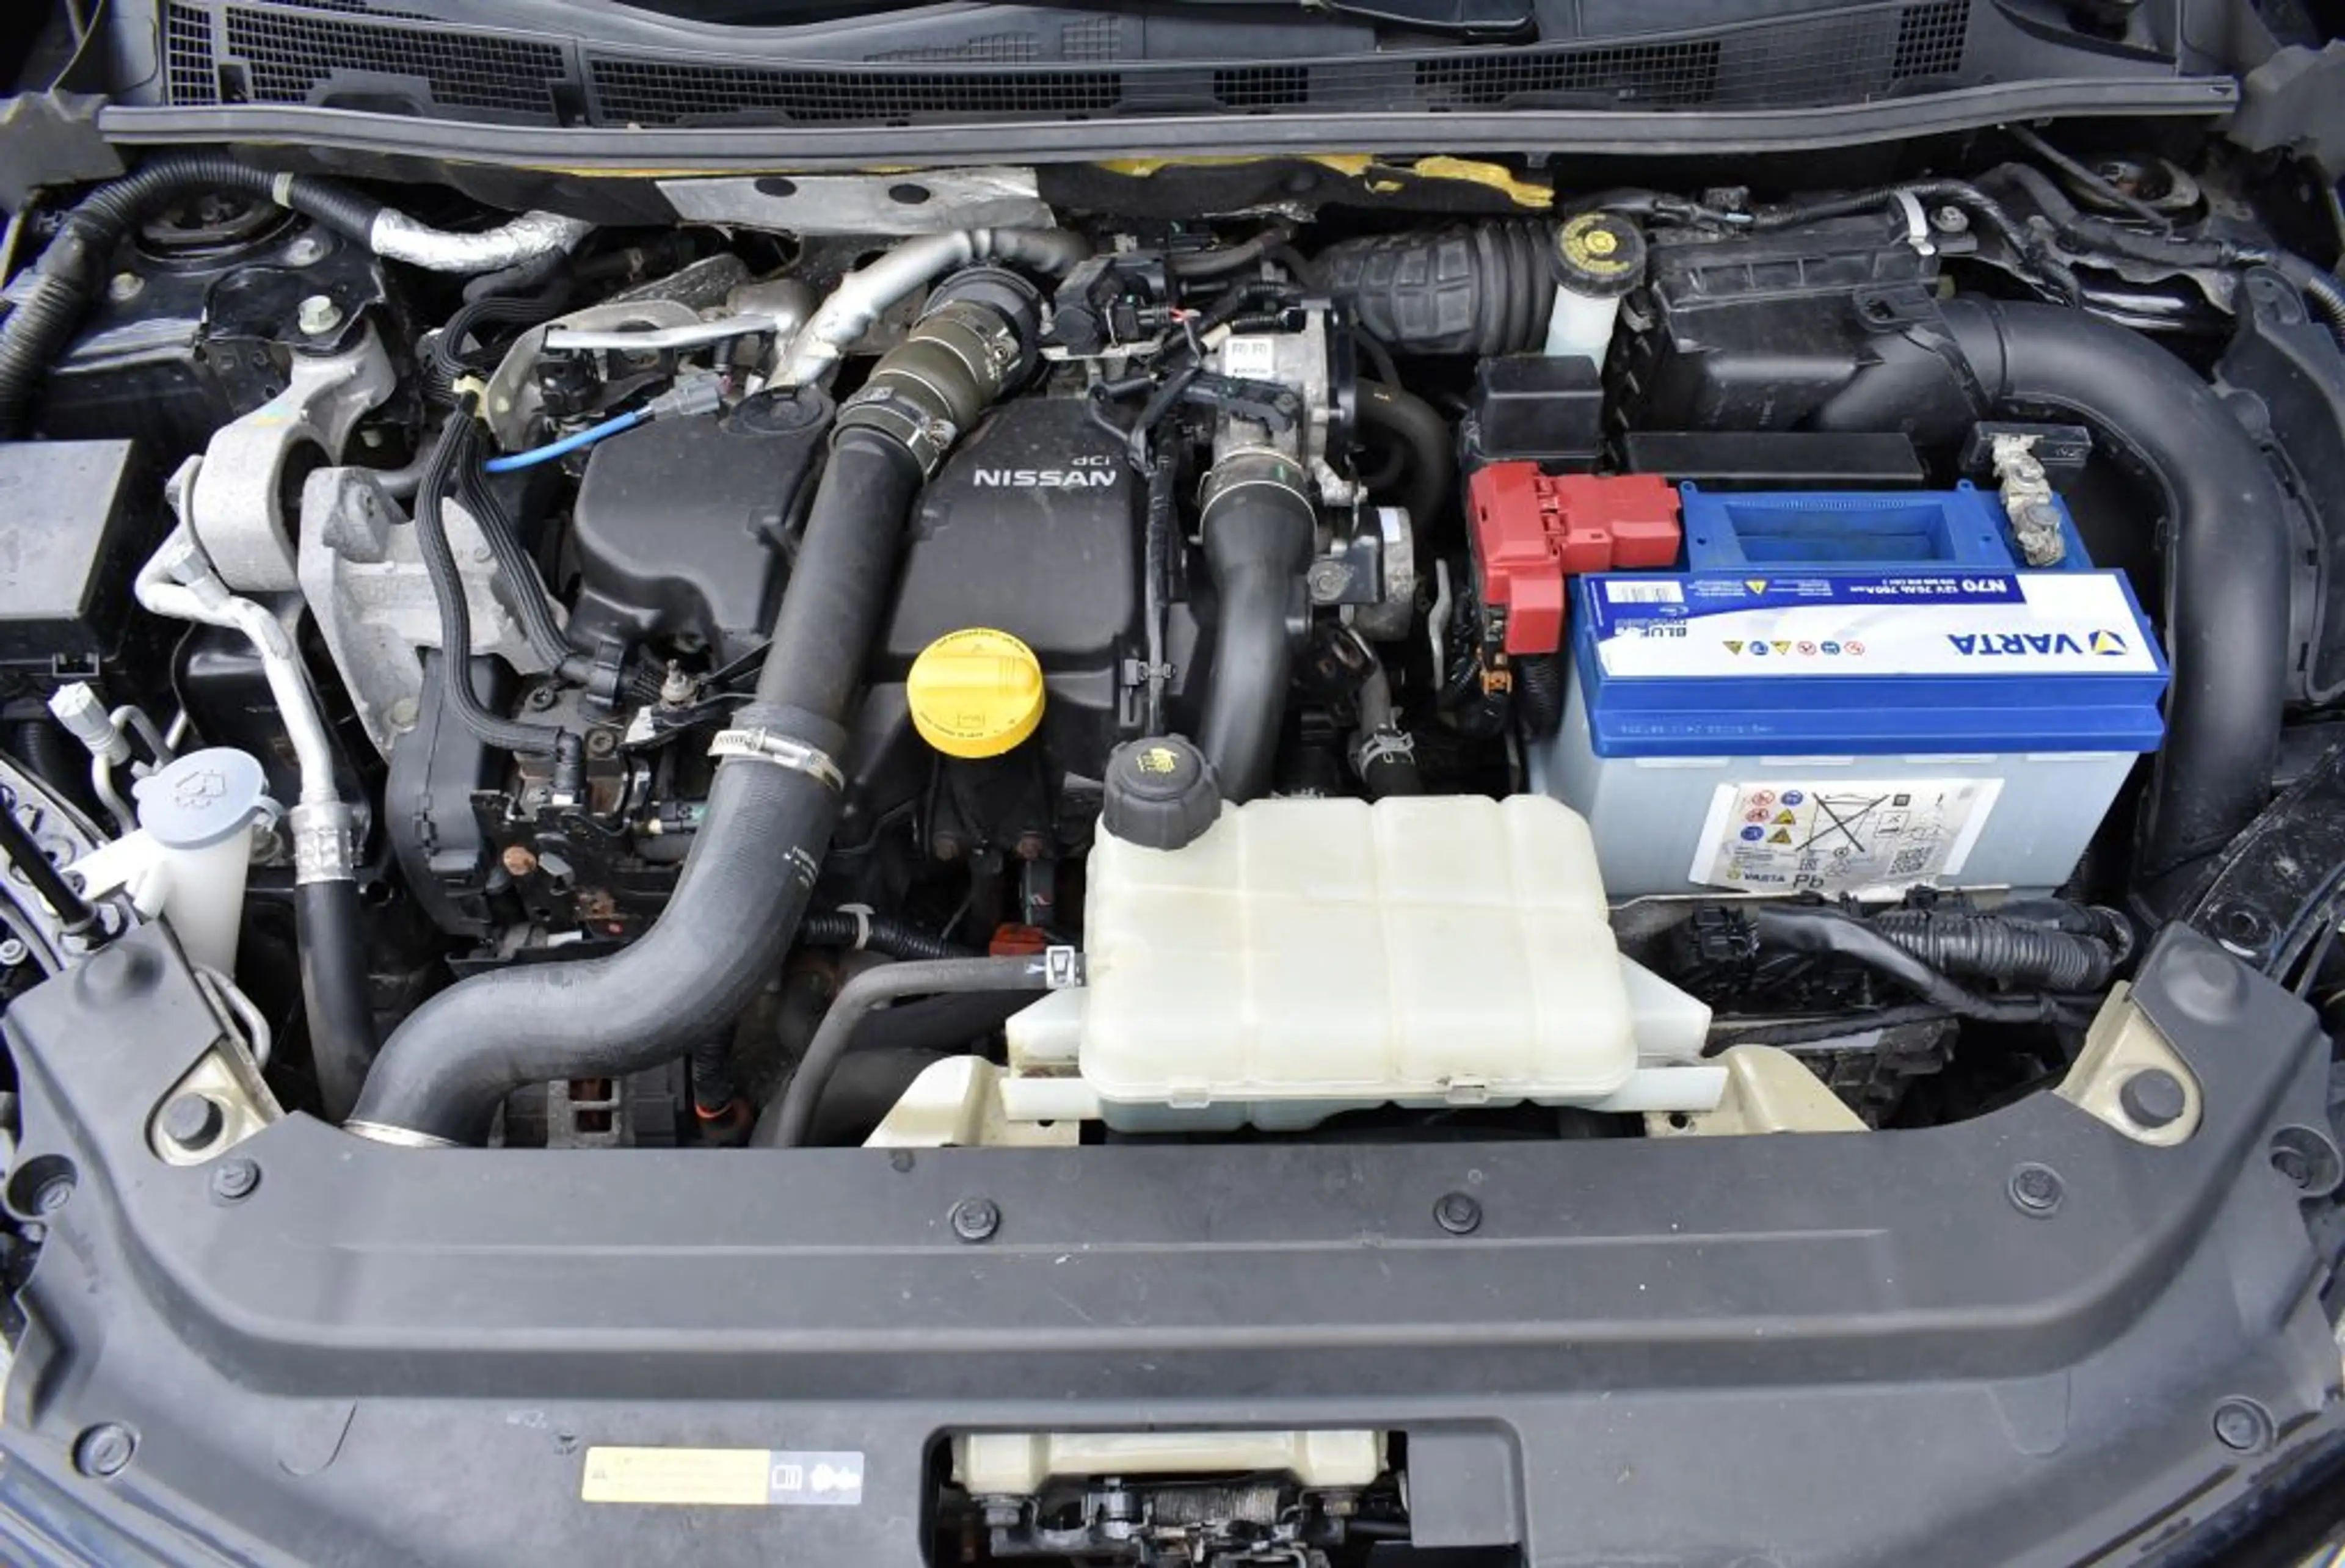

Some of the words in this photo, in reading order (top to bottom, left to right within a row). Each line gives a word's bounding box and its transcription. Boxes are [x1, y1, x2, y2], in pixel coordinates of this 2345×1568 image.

[1071, 455, 1110, 465] dCi
[973, 469, 1116, 486] NISSAN
[1961, 579, 2007, 592] N70
[1946, 634, 2084, 655] VARTA
[1793, 874, 1824, 889] Pb
